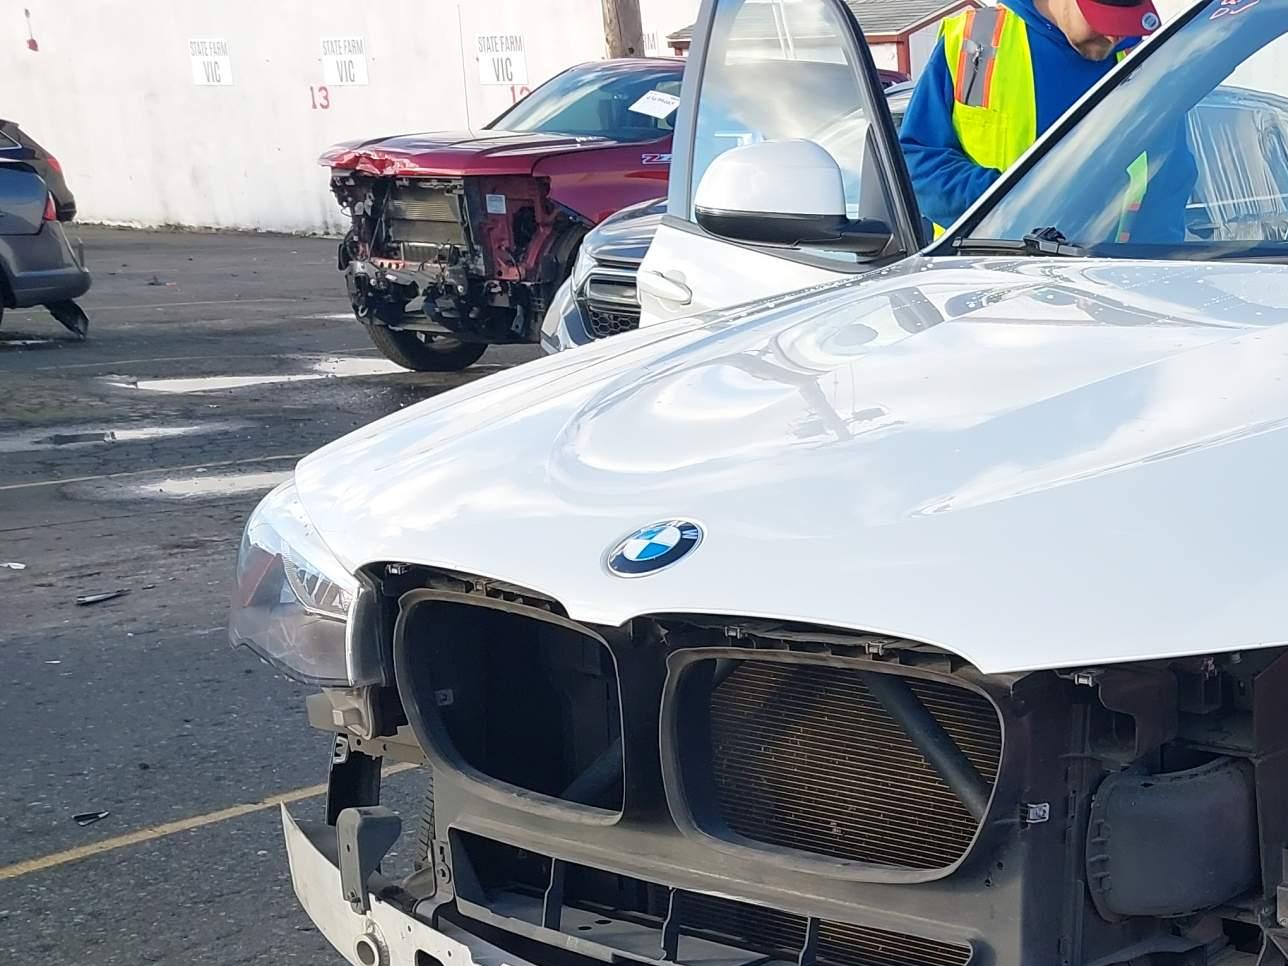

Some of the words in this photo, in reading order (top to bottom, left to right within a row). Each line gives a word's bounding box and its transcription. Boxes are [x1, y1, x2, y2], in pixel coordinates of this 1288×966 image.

[478, 35, 499, 53] STATE
[500, 35, 522, 53] FARM
[202, 60, 221, 83] VIC
[336, 59, 356, 83] VIC
[492, 57, 513, 82] VIC
[309, 86, 330, 110] 13
